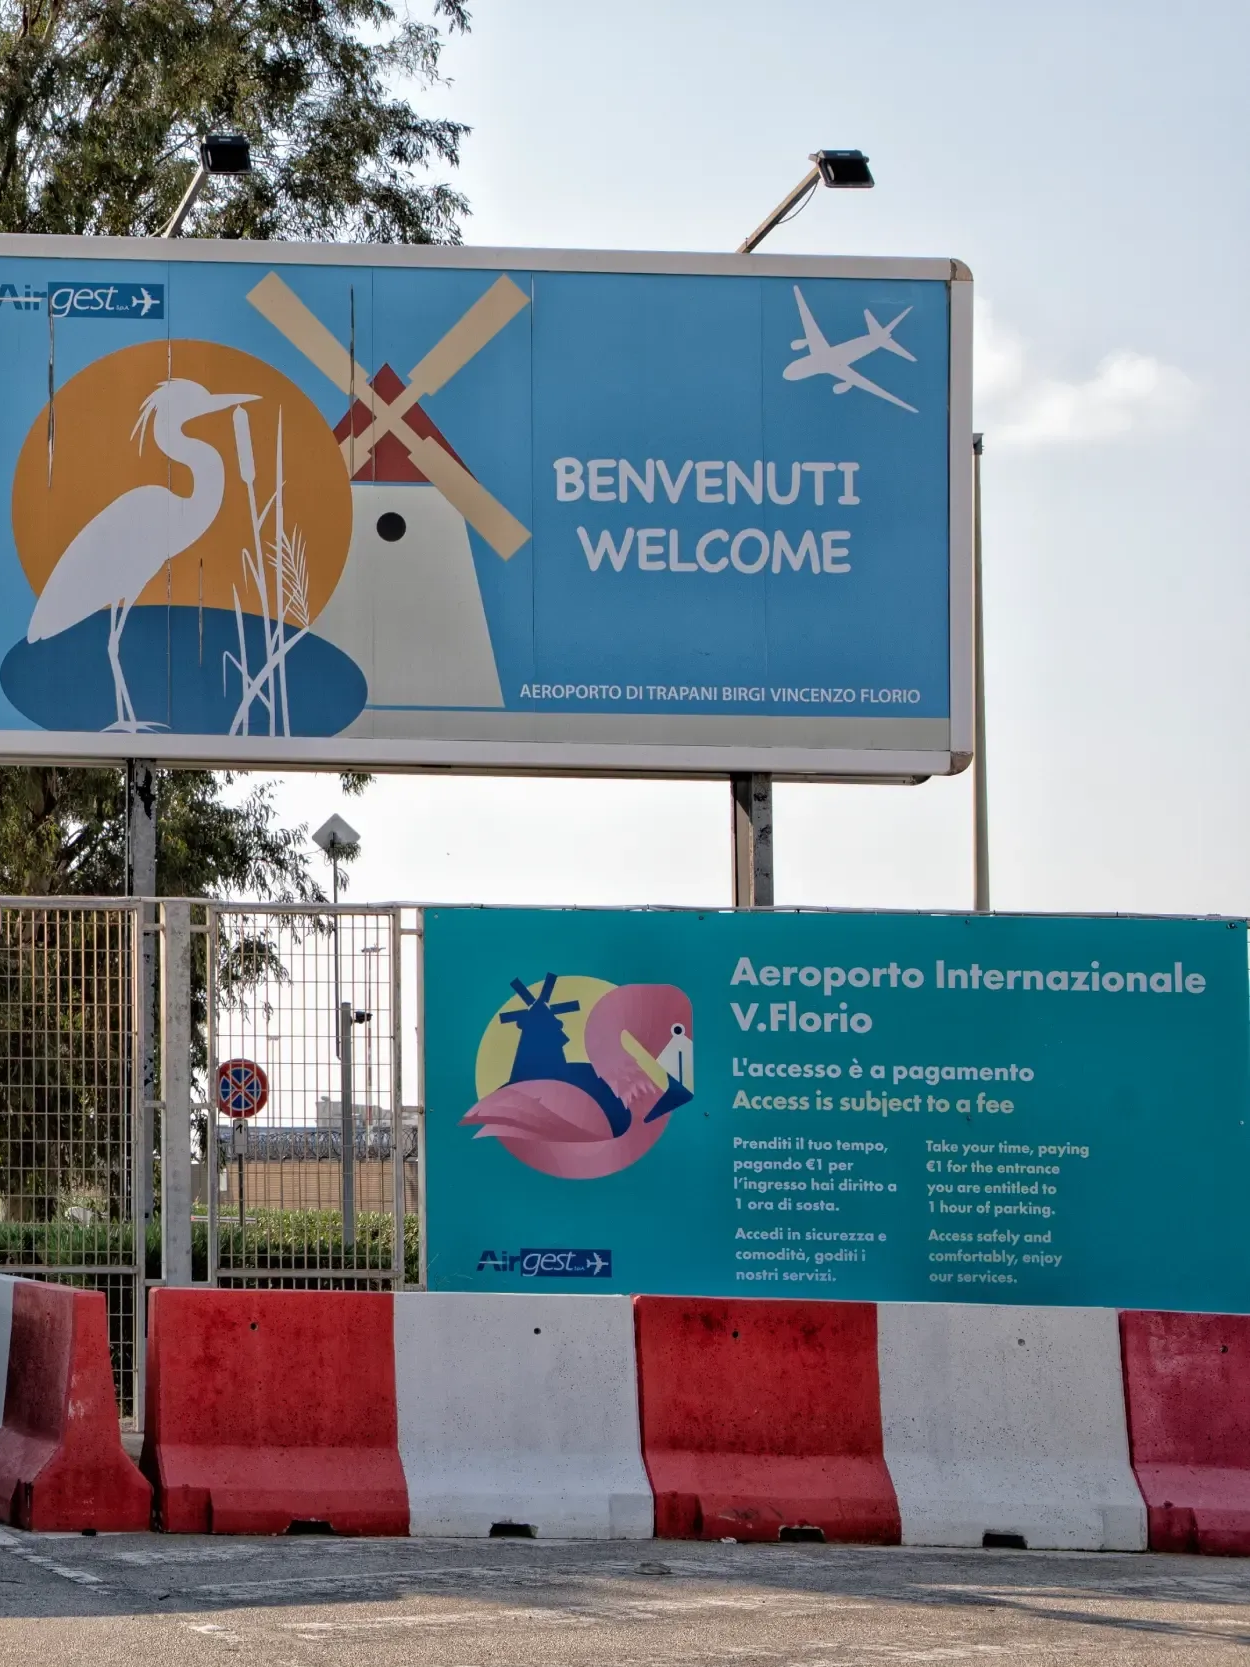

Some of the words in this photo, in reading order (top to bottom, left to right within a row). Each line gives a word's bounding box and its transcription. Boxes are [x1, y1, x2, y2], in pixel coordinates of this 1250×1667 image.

[553, 457, 860, 505] BENVENUTI
[577, 526, 851, 574] WELCOME
[520, 684, 621, 699] AEROPORTO
[627, 686, 642, 700] DI
[646, 686, 717, 700] TRAPANI
[723, 687, 765, 701] BIRGI
[771, 688, 855, 702] VINCENZO
[861, 689, 920, 703] FLORIO
[730, 957, 924, 996] Aeroporto
[936, 960, 1206, 994] Internazionale
[730, 1001, 873, 1033] V.Florio
[733, 1057, 842, 1078] L'accesso
[848, 1058, 864, 1078] è
[869, 1065, 886, 1079] a
[893, 1064, 1034, 1085] pagamento
[732, 1090, 810, 1110] Access
[816, 1089, 833, 1110] is
[840, 1090, 922, 1117] subject
[927, 1095, 950, 1113] to
[955, 1099, 971, 1113] a
[976, 1092, 1014, 1114] fee
[734, 1137, 791, 1149] Prenditi
[796, 1137, 804, 1150] il
[808, 1140, 832, 1150] tuo
[836, 1140, 888, 1154] tempo,
[926, 1140, 958, 1152] Take
[962, 1144, 995, 1156] your
[999, 1141, 1034, 1156] time,
[1038, 1142, 1089, 1158] paying
[734, 1157, 802, 1173] pagando
[805, 1158, 822, 1170] €1
[829, 1162, 854, 1174] per
[926, 1160, 941, 1172] €1
[947, 1160, 967, 1172] for
[971, 1160, 993, 1173] the
[997, 1163, 1060, 1174] entrance
[734, 1177, 807, 1193] l'ingresso
[811, 1178, 834, 1190] hai
[838, 1178, 884, 1191] diritto
[887, 1184, 898, 1192] a
[927, 1184, 953, 1196] you
[957, 1185, 980, 1193] are
[984, 1181, 1038, 1194] entitled
[1042, 1184, 1057, 1194] to
[735, 1198, 742, 1209] 1
[748, 1201, 774, 1210] ora
[778, 1198, 792, 1210] di
[796, 1200, 839, 1211] sosta.
[928, 1201, 935, 1212] 1
[940, 1200, 972, 1213] hour
[976, 1201, 990, 1213] of
[994, 1201, 1055, 1218] parking.
[735, 1227, 783, 1240] Accedi
[788, 1228, 800, 1240] in
[805, 1228, 874, 1241] sicurezza
[877, 1233, 887, 1241] e
[928, 1229, 973, 1241] Access
[977, 1229, 1020, 1245] safely
[1024, 1231, 1051, 1243] and
[736, 1248, 810, 1262] comodità,
[815, 1249, 857, 1264] goditi
[861, 1249, 866, 1261] i
[929, 1249, 1018, 1266] comfortably,
[1023, 1251, 1062, 1267] enjoy
[736, 1268, 778, 1280] nostri
[783, 1269, 836, 1281] servizi.
[929, 1273, 953, 1282] our
[957, 1271, 1017, 1283] services.
